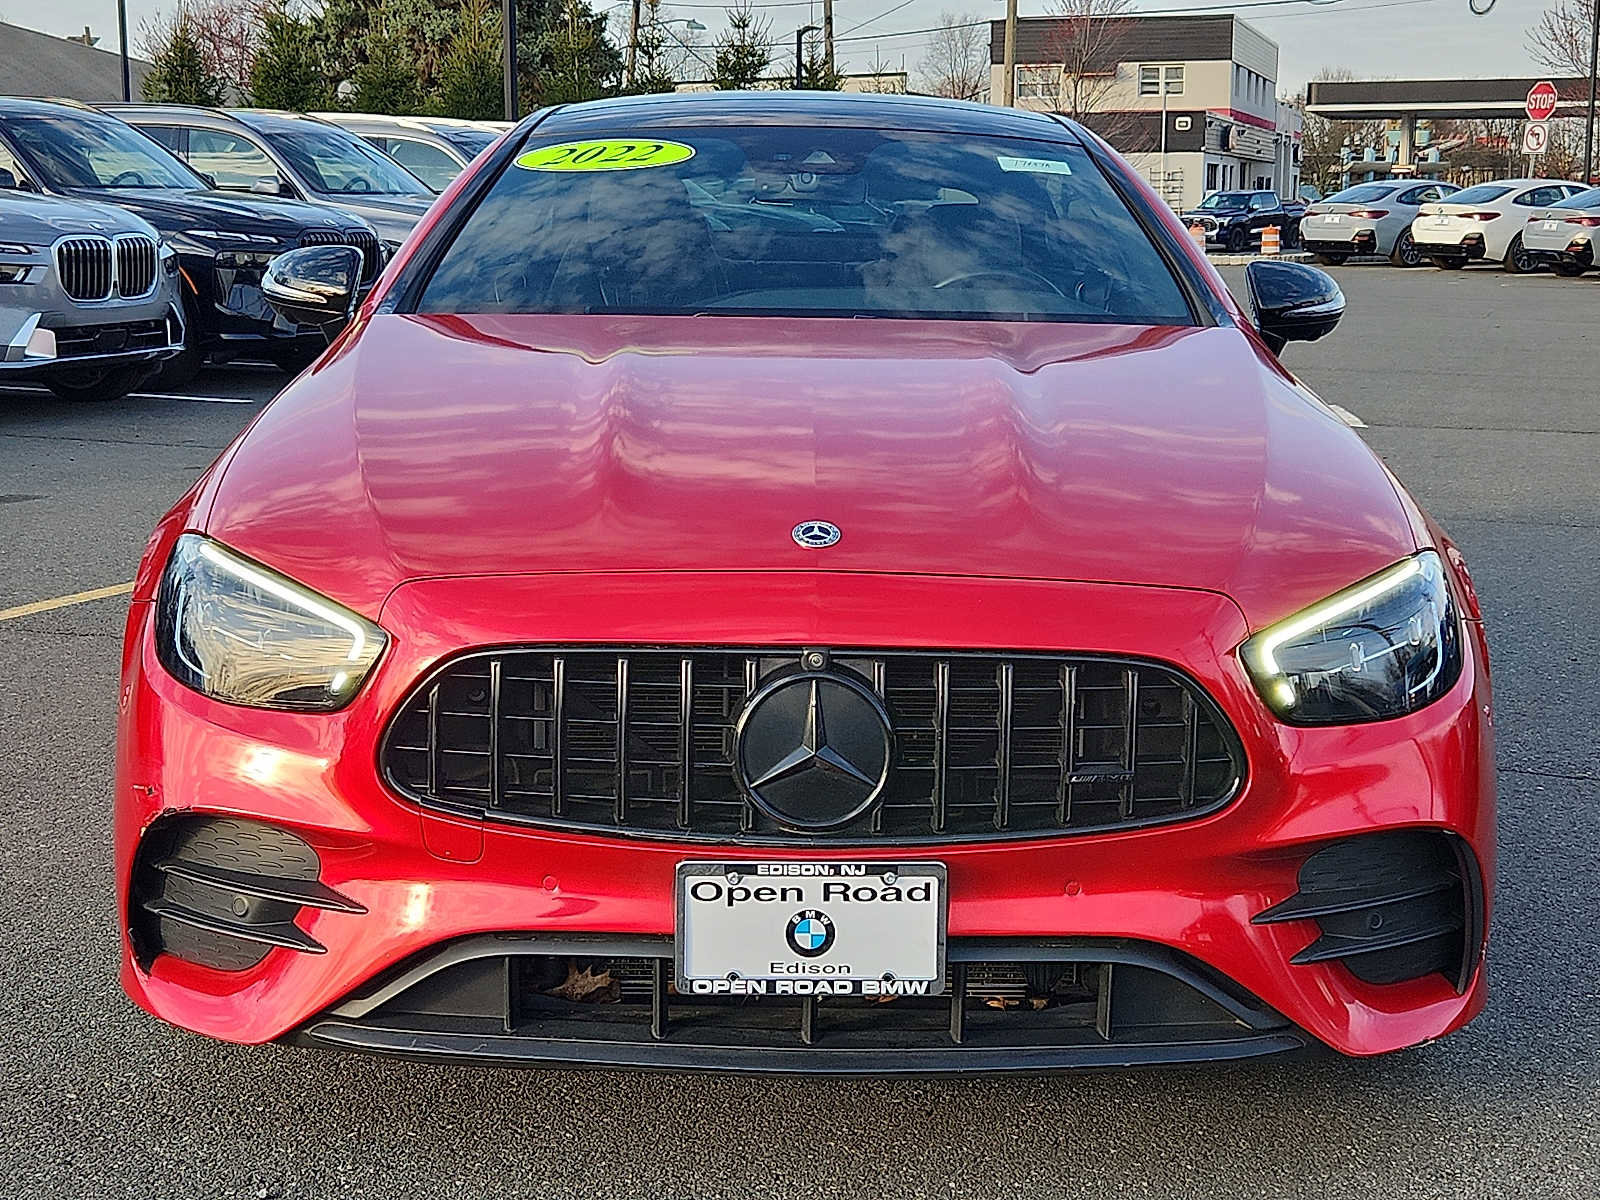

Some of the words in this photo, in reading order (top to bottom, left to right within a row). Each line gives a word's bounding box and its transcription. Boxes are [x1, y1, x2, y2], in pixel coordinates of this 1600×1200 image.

[1528, 93, 1555, 110] STOP
[539, 144, 664, 166] 2022
[757, 864, 835, 877] EDISON,
[840, 864, 866, 876] NJ
[690, 881, 804, 907] Open
[822, 882, 931, 902] Road
[791, 910, 831, 925] BMW
[770, 962, 851, 974] Edison
[692, 980, 766, 995] OPEN
[775, 980, 854, 995] ROAD
[861, 980, 929, 995] BMW
